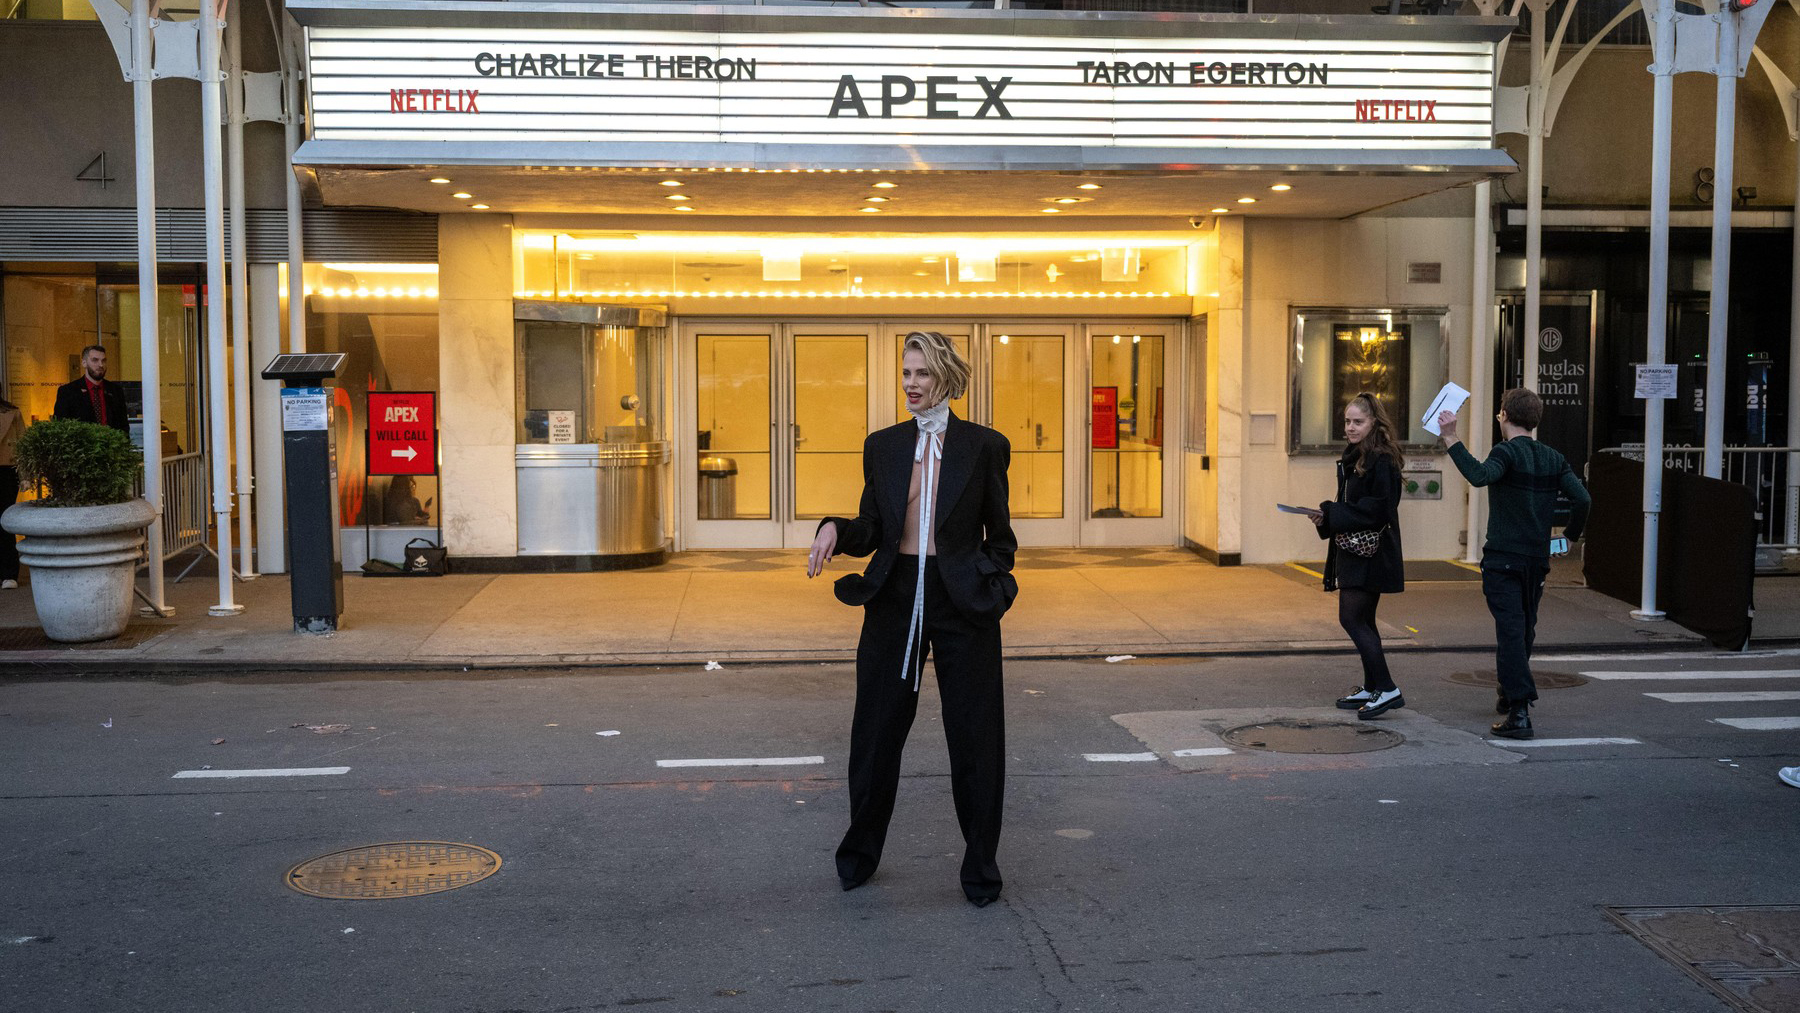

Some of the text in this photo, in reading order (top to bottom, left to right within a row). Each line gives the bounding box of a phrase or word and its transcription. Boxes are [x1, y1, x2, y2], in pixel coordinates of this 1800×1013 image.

[475, 52, 756, 80] CHARLIZE THERON
[1077, 61, 1328, 85] TARON EGERTON
[389, 89, 480, 114] NETFLIX
[827, 75, 1014, 119] APEX
[1356, 100, 1437, 123] NETFLIX
[76, 151, 115, 189] 4
[384, 406, 419, 422] APEX
[376, 429, 428, 441] WILL CALL
